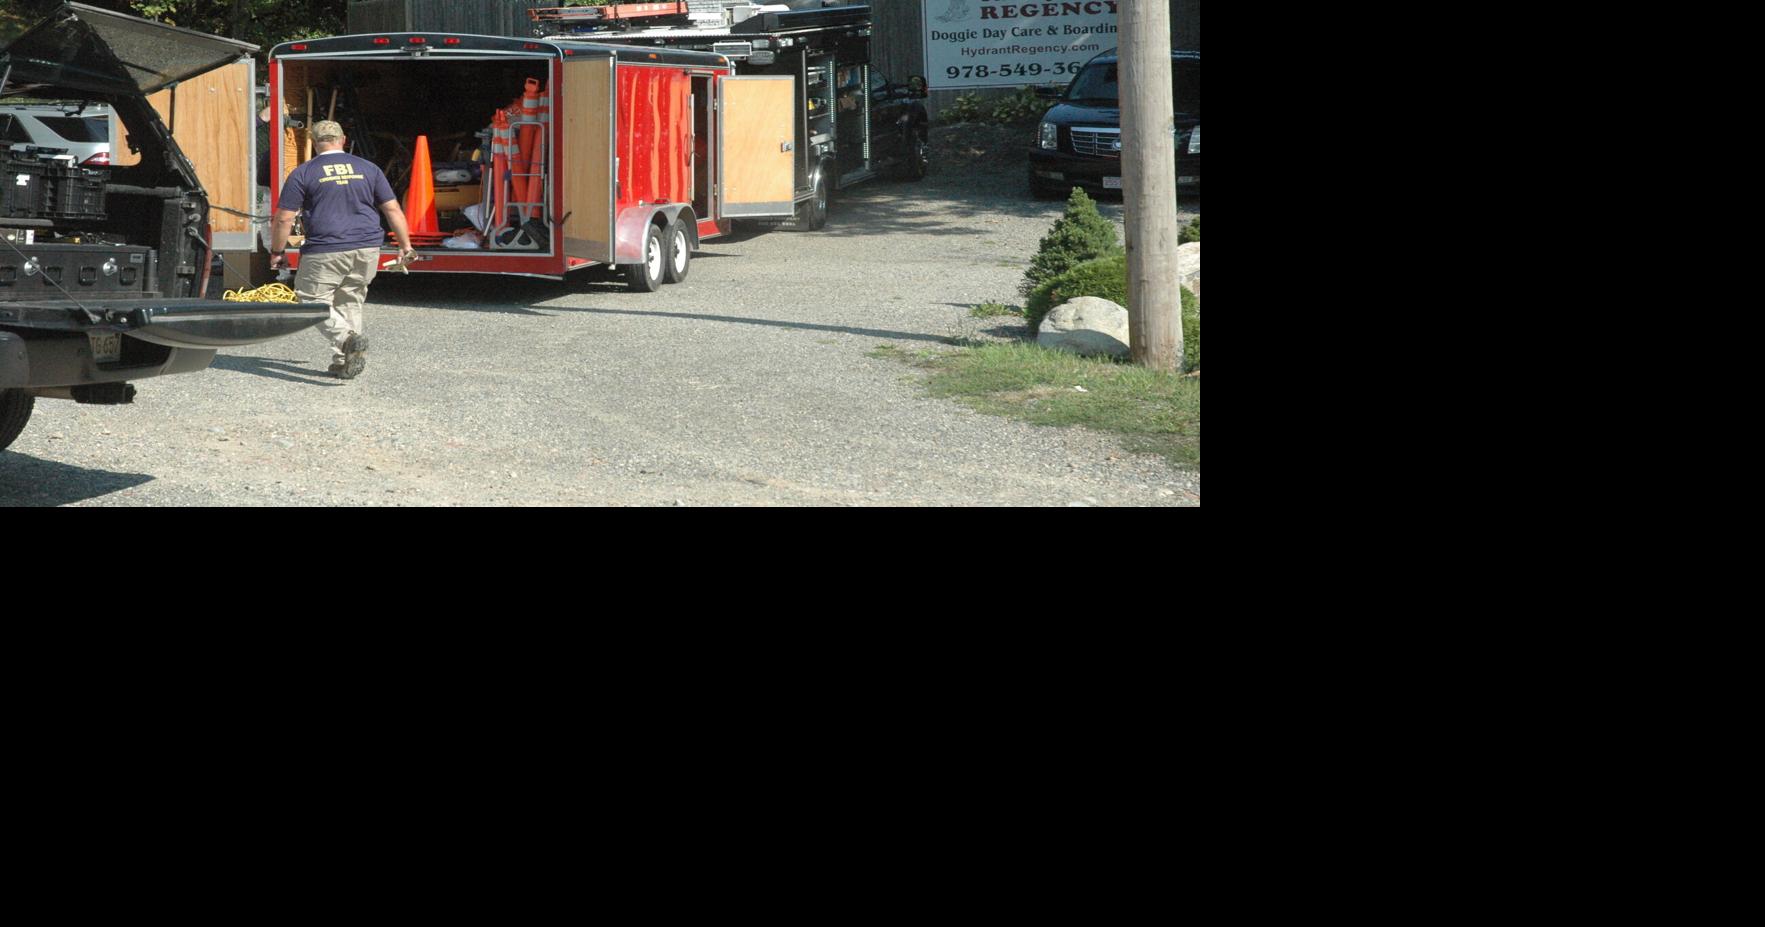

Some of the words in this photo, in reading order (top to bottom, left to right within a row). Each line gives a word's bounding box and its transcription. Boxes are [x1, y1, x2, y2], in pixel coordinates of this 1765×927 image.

[979, 0, 1117, 19] REGENCY
[931, 29, 977, 42] Doggie
[983, 27, 1007, 40] Day
[1011, 26, 1042, 37] Care
[1047, 25, 1058, 35] &
[1063, 23, 1117, 35] Boardin
[961, 43, 1099, 57] HydrantRegency.com
[946, 61, 1081, 79] 978-549-36
[323, 163, 354, 176] FBI
